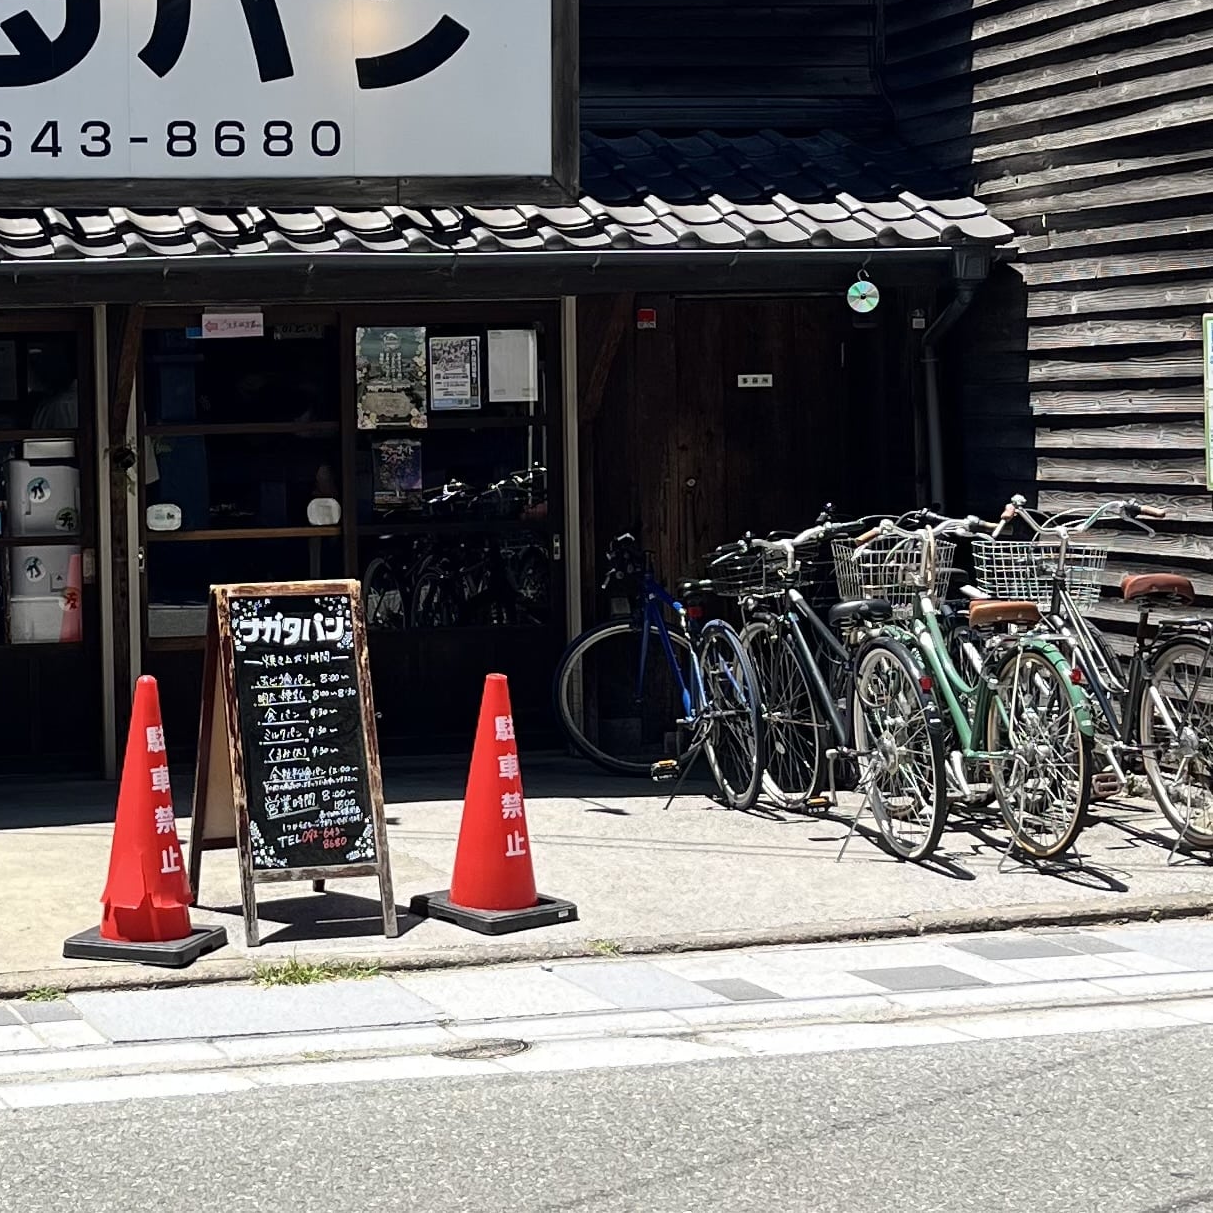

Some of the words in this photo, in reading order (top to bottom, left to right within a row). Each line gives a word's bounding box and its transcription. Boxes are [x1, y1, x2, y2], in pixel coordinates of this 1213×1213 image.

[240, 612, 344, 646] ナガタパン
[145, 724, 181, 874] 駐車禁止
[277, 834, 302, 848] TEL
